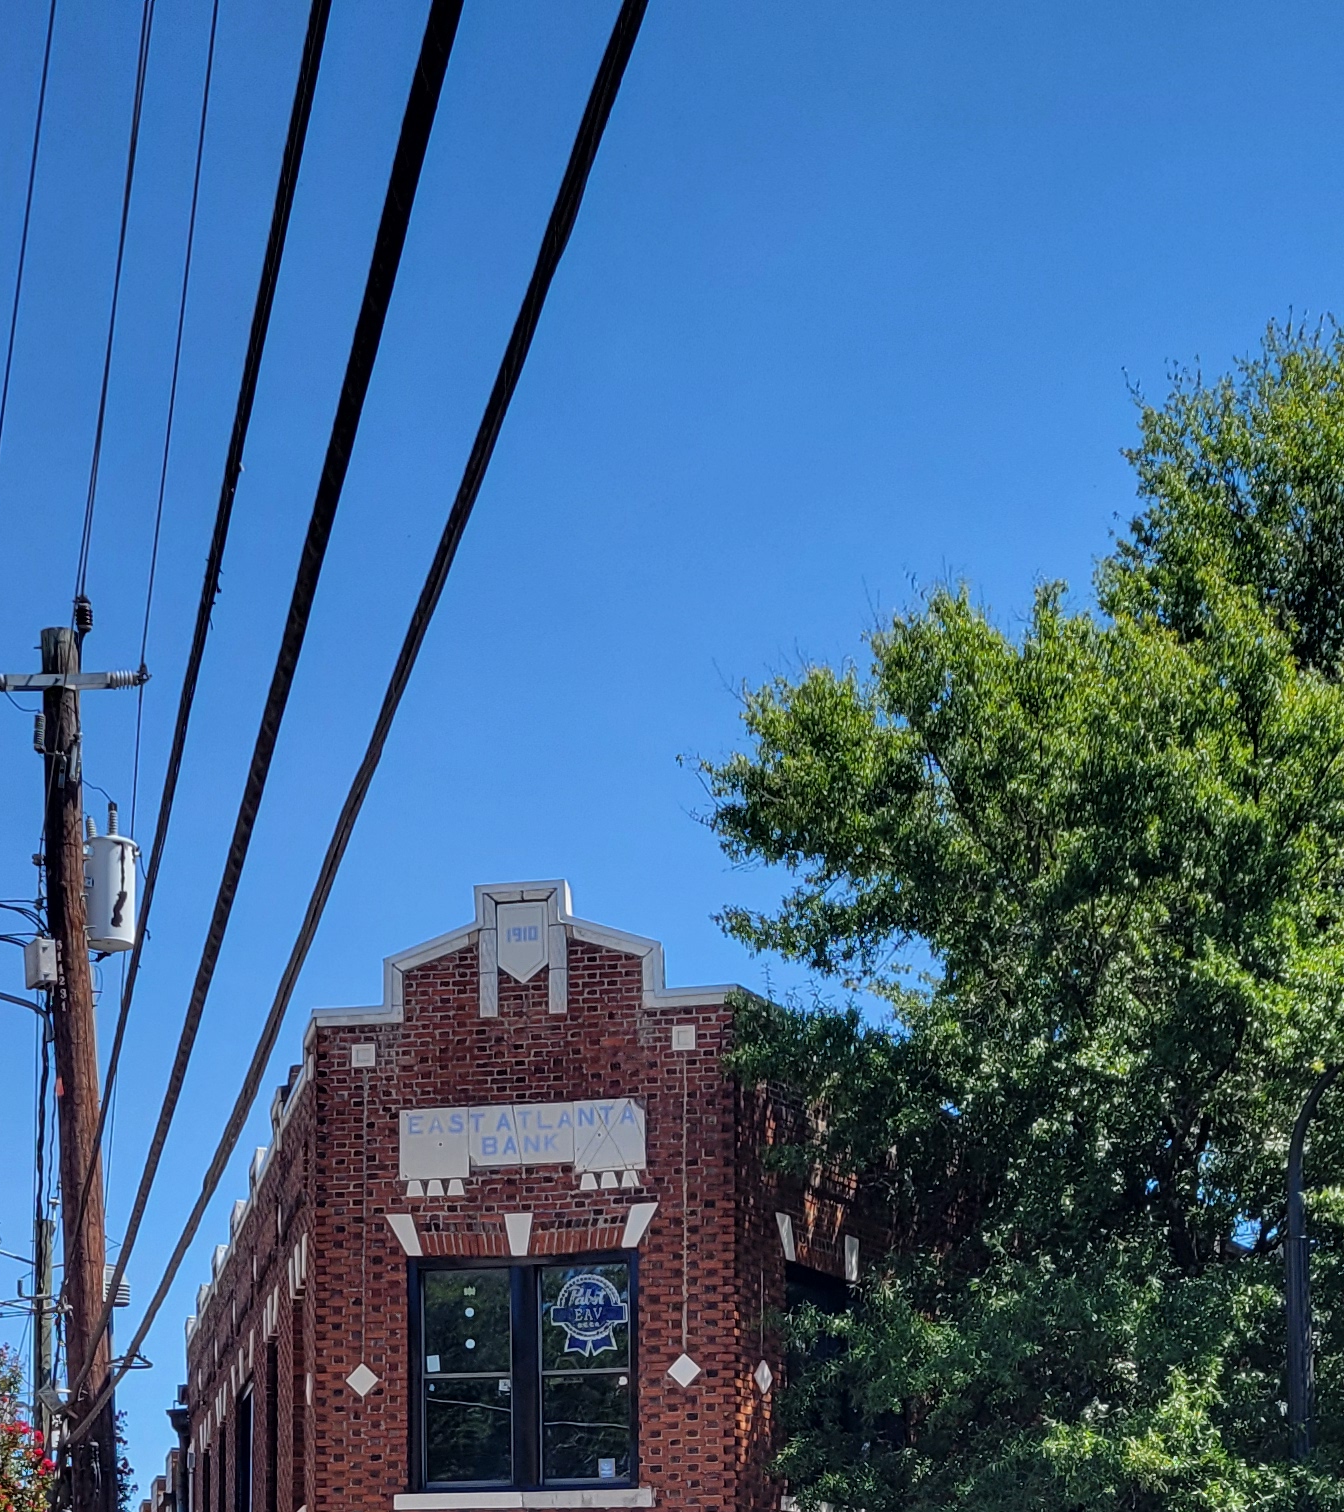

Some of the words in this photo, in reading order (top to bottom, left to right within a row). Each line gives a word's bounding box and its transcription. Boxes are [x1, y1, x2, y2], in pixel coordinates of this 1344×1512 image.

[506, 926, 538, 943] 1910
[407, 1113, 486, 1134] EAST
[496, 1104, 636, 1131] ATLANTA
[481, 1133, 579, 1155] BANK
[567, 1286, 607, 1307] Pabst
[574, 1307, 603, 1321] EAV
